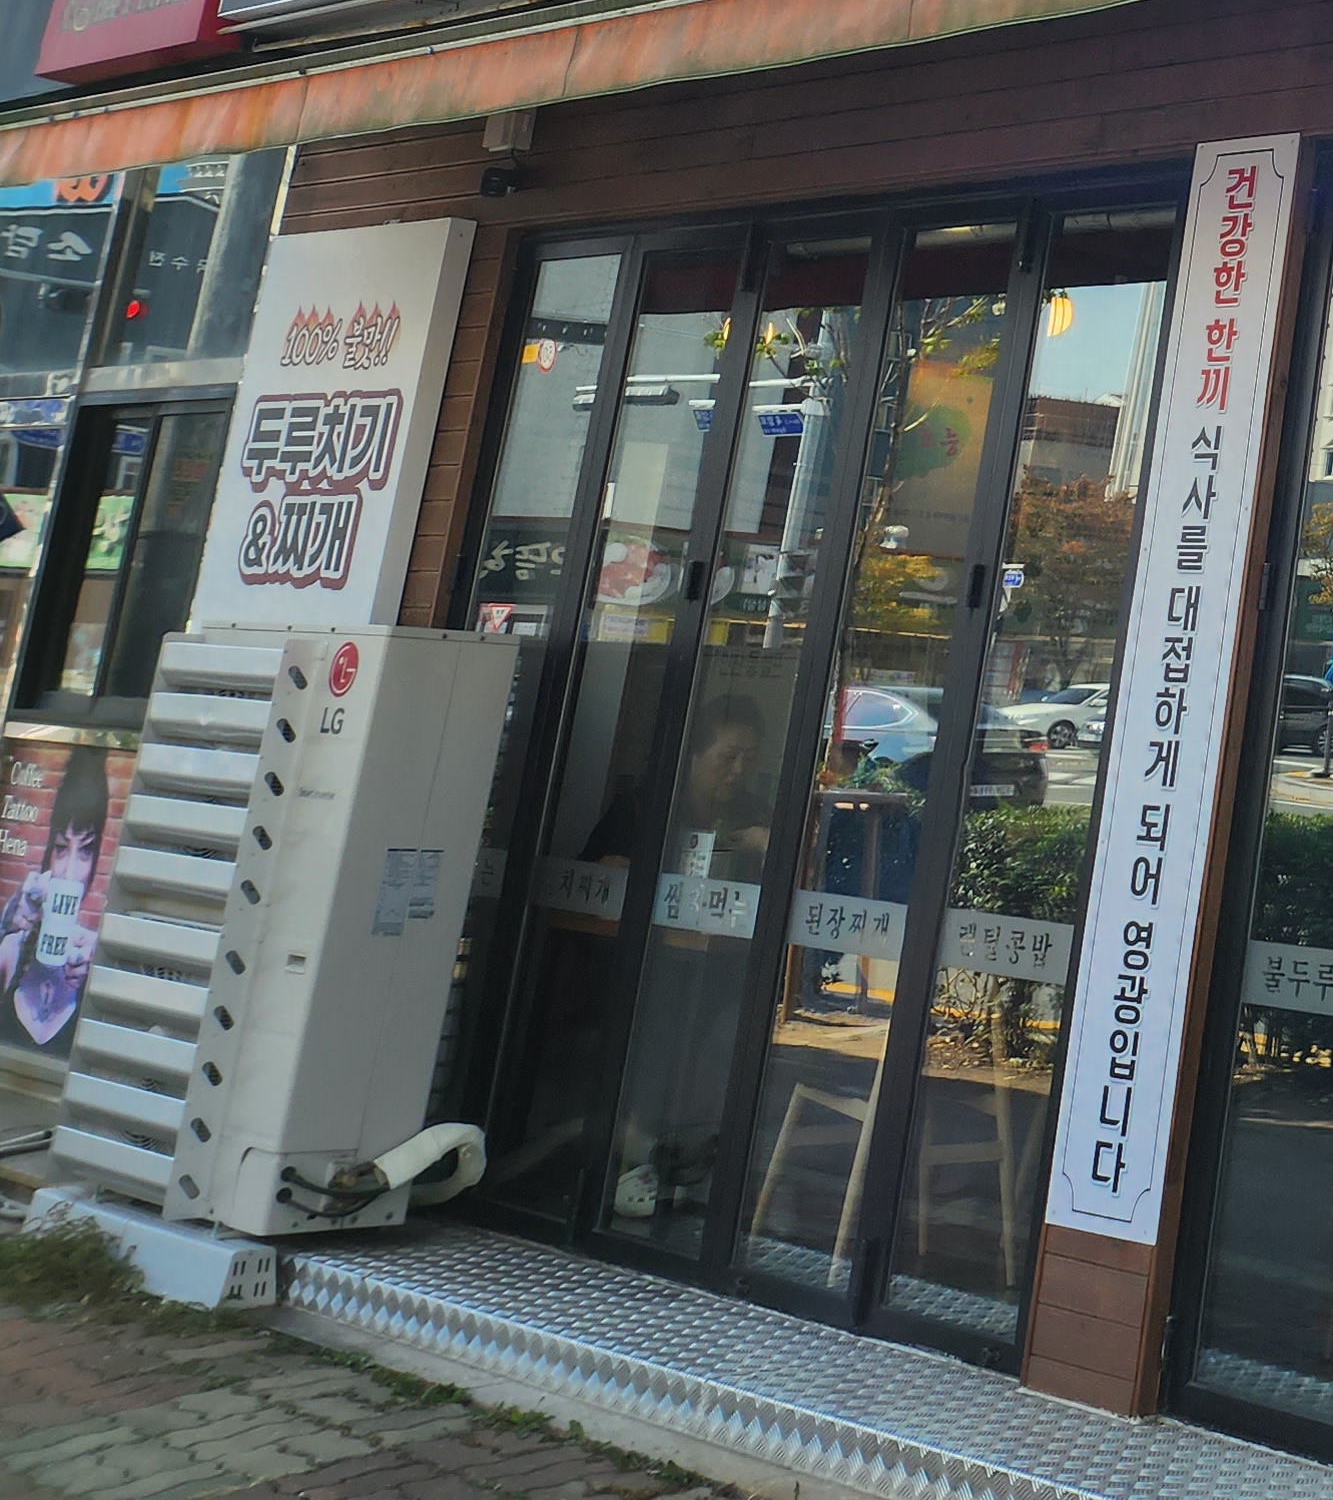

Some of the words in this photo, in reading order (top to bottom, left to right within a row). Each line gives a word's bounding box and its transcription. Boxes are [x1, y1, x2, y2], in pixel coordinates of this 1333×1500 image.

[1213, 166, 1257, 306] 건강한
[281, 318, 343, 367] 100%
[343, 316, 400, 369] 불맛!!
[1196, 318, 1238, 411] 한끼
[242, 396, 397, 482] 두루치기
[1175, 425, 1224, 572] 식사를
[320, 707, 345, 734] LG
[1144, 585, 1202, 789] 대접하게
[1129, 803, 1171, 906] 되어
[39, 932, 69, 957] FREE
[51, 892, 79, 918] LIVE
[804, 903, 890, 942] 된장찌개
[1090, 920, 1155, 1194] 영광입니다
